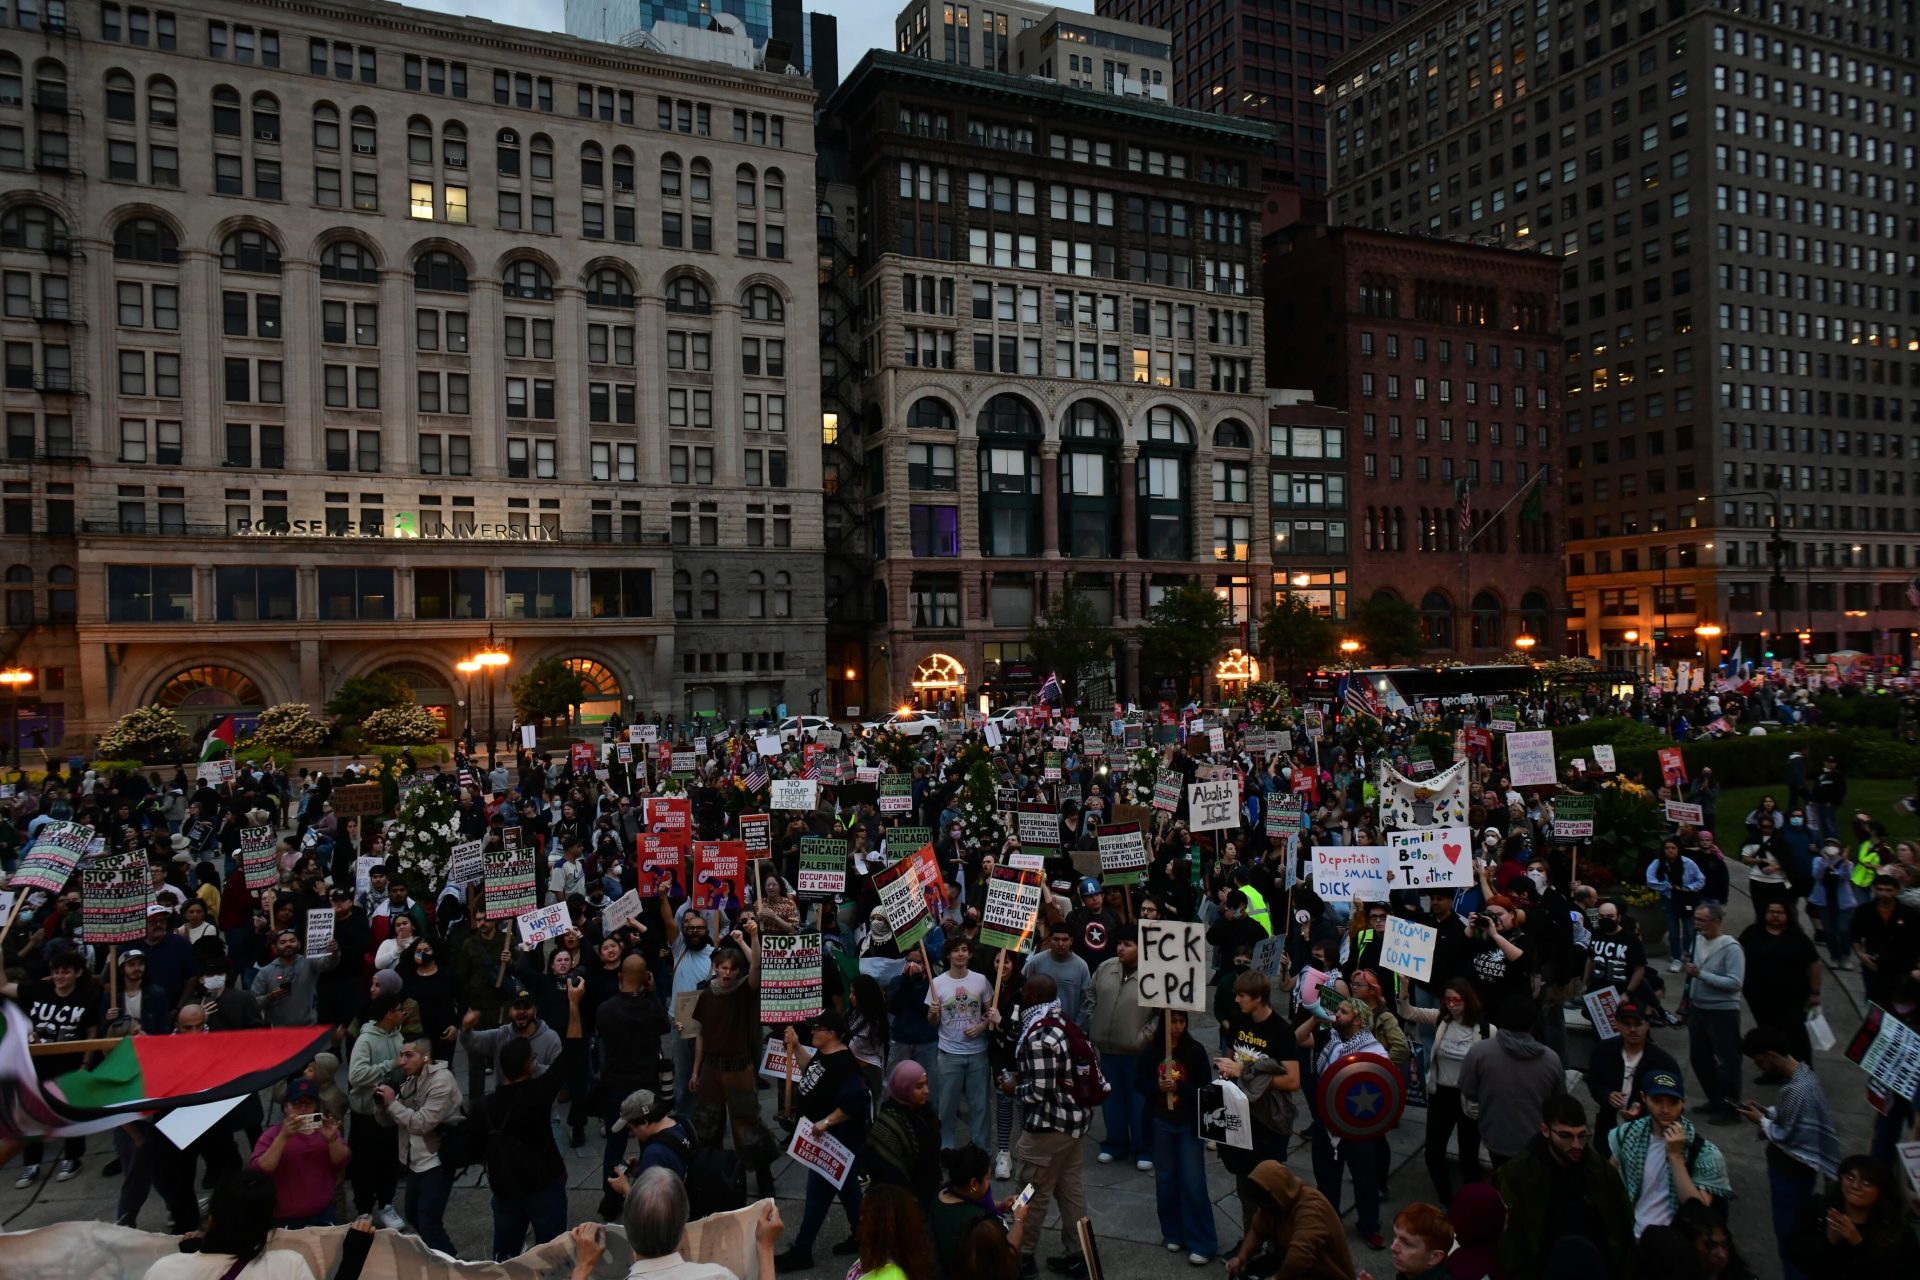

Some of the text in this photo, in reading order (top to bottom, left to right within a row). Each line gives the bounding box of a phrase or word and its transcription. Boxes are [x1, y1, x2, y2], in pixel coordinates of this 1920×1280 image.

[237, 518, 384, 537] ROOSEVELT
[424, 522, 556, 541] UNIVERSITY
[1192, 782, 1232, 804] Abolish
[1269, 793, 1287, 801] STOP
[335, 800, 382, 814] REAL BAD
[774, 801, 812, 809] FASCISM
[1556, 800, 1594, 809] CHICAGO
[1201, 801, 1231, 825] ICE
[43, 821, 94, 840] STOP THE
[241, 827, 268, 839] STOP
[241, 837, 264, 845] TRUMP
[887, 834, 929, 844] CHICAGO
[1099, 836, 1126, 844] SUPPORT
[453, 843, 481, 855] NO TO
[801, 844, 846, 855] CHICAGO
[1100, 840, 1142, 851] REFERENDUM
[454, 849, 481, 860] DEPORT
[455, 853, 481, 864] ATIONS
[484, 848, 534, 864] STOP THE
[702, 849, 719, 857] STOP
[1121, 851, 1144, 861] POLICE
[94, 848, 147, 870] STOP THE
[484, 859, 535, 870] TRUMP AGENDA!
[1319, 852, 1380, 870] Deportation
[456, 864, 483, 874] DEPORT
[800, 861, 845, 871] PALESTINE
[84, 868, 145, 883] STOP THE
[799, 873, 844, 882] OCCUPATION
[1344, 869, 1383, 879] SMALL
[83, 880, 145, 890] TRUMP AGENDA!
[810, 881, 816, 889] A
[818, 882, 843, 890] CRIME!
[880, 877, 907, 898] SUPPORT
[990, 880, 1039, 897] SUPPORT THE
[1087, 882, 1095, 892] A
[1319, 882, 1351, 897] DICK
[83, 891, 121, 899] IMMIGRANT
[485, 893, 519, 902] REPRODUCTIVE
[988, 889, 1037, 906] REFERENDUM
[100, 906, 121, 914] POLICE
[888, 905, 906, 922] OVER
[986, 904, 1036, 921] OVER POLICE
[83, 916, 124, 924] REPRODUCTIVE
[529, 913, 561, 930] HATRED
[529, 923, 565, 942] RED HAT
[1390, 918, 1431, 942] TRUMP
[763, 934, 820, 950] STOP THE
[1403, 940, 1409, 948] A
[762, 948, 821, 958] TRUMP AGENDA!
[1386, 947, 1426, 972] CUNT
[1485, 961, 1507, 972] SIEGE
[1482, 967, 1505, 978] GAZA
[1873, 1024, 1904, 1079] REFERENDUM
[1893, 1066, 1910, 1091] OVER
[801, 1140, 841, 1169] I.C.E. OUT OF
[830, 1145, 848, 1163] ILLINOIS
[798, 1148, 839, 1177] EVERYWHERE
